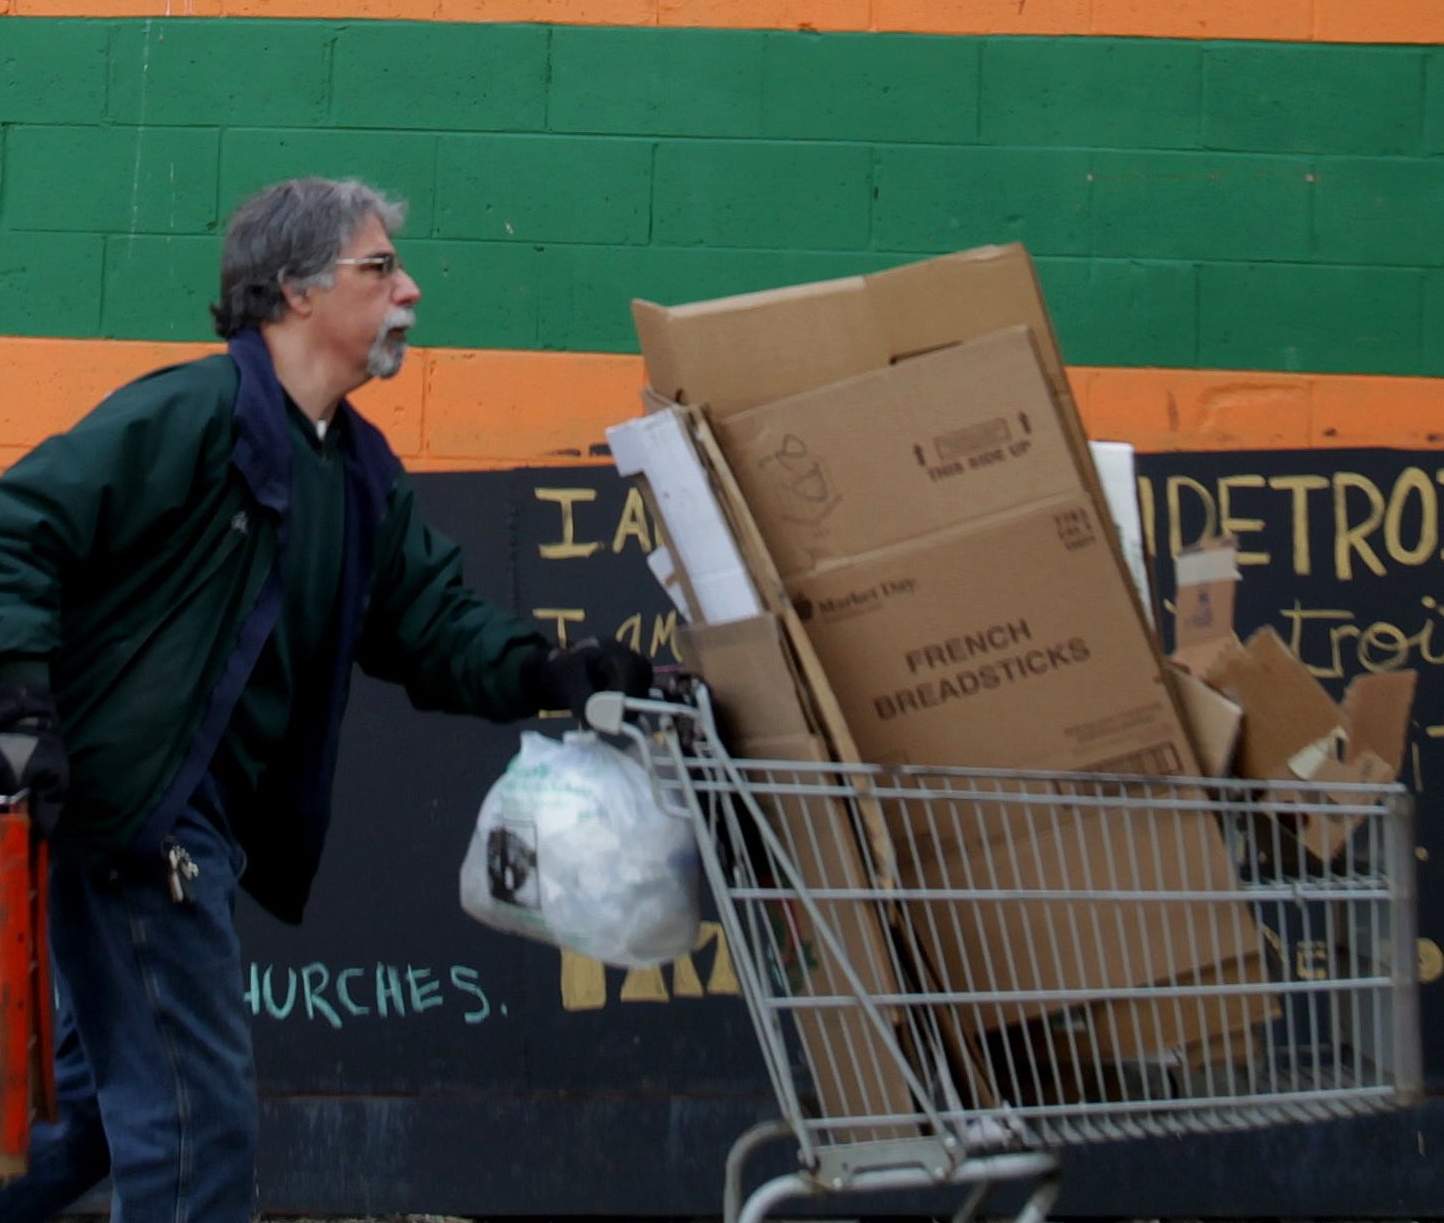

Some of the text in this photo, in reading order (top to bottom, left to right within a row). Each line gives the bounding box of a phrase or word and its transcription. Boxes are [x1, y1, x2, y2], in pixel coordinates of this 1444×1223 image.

[1009, 439, 1033, 459] UP
[612, 487, 665, 554] A
[904, 617, 1033, 674] FRENCH
[872, 637, 1091, 721] BREADSTICKS
